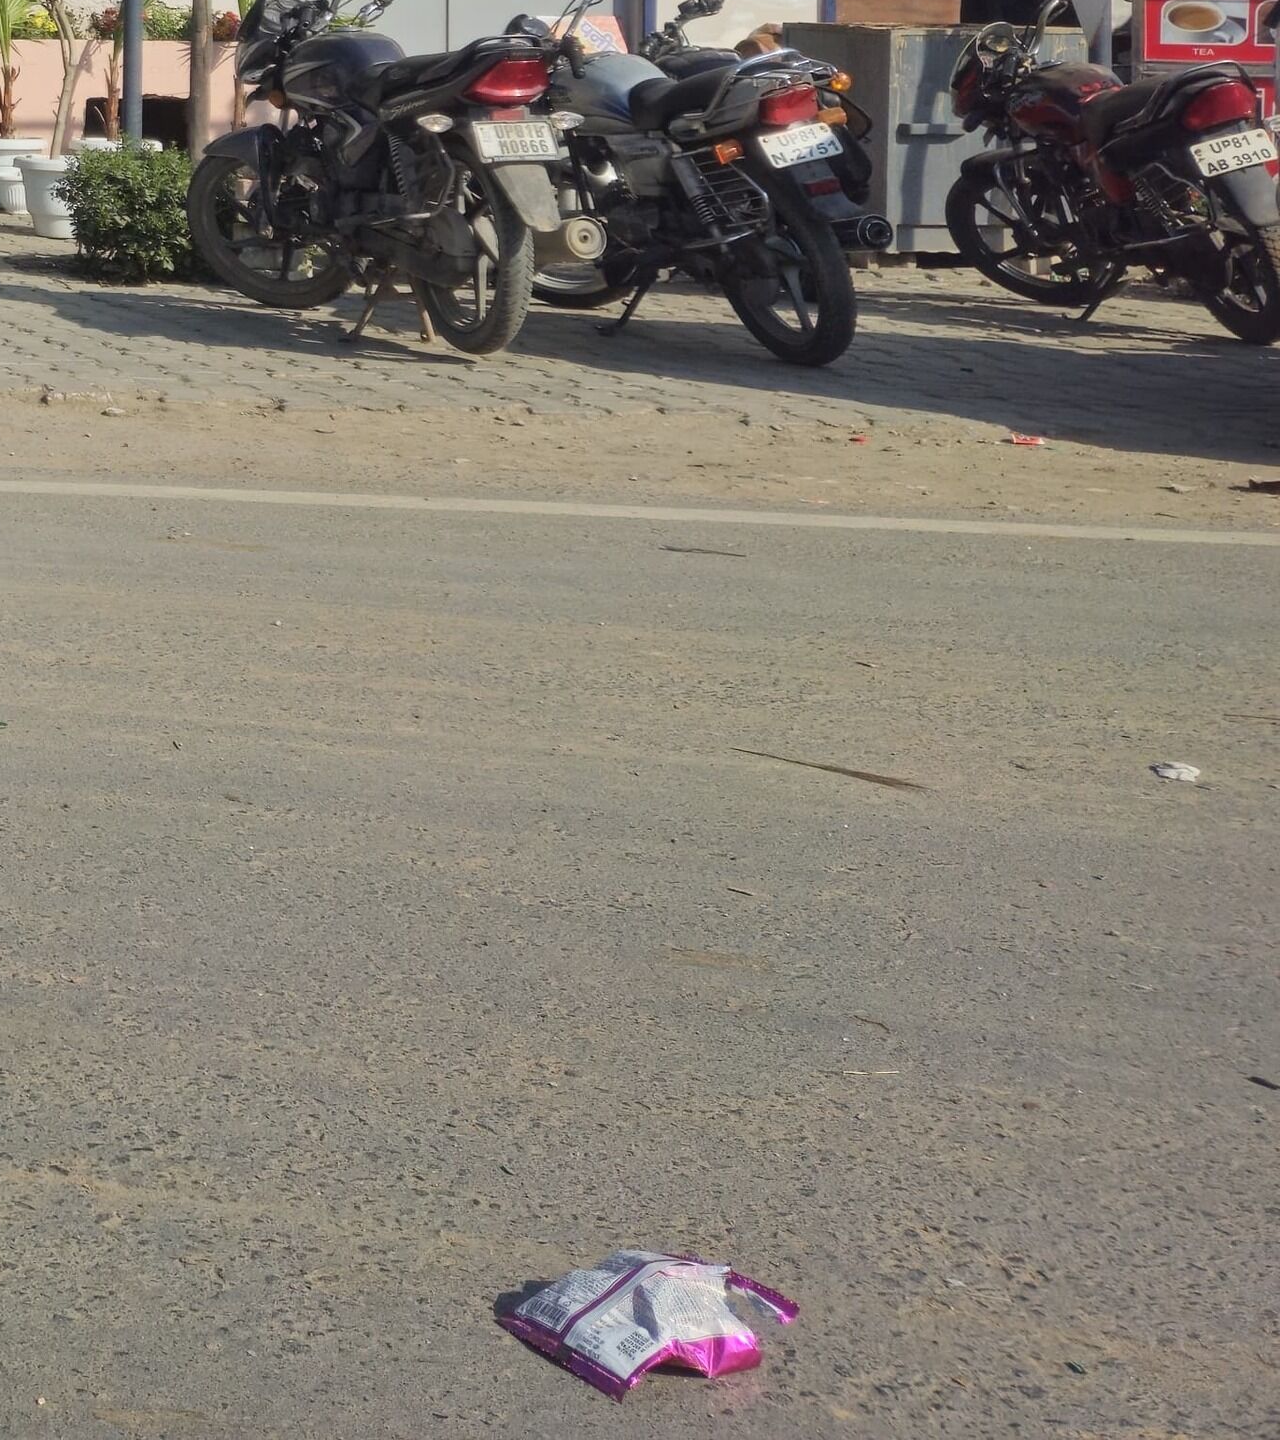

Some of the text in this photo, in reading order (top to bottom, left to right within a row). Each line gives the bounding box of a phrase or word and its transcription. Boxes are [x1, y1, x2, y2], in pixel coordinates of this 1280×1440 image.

[1192, 47, 1215, 56] TEA
[776, 127, 818, 147] UP81
[1209, 135, 1251, 154] UP81
[1207, 148, 1272, 175] AB 3910
